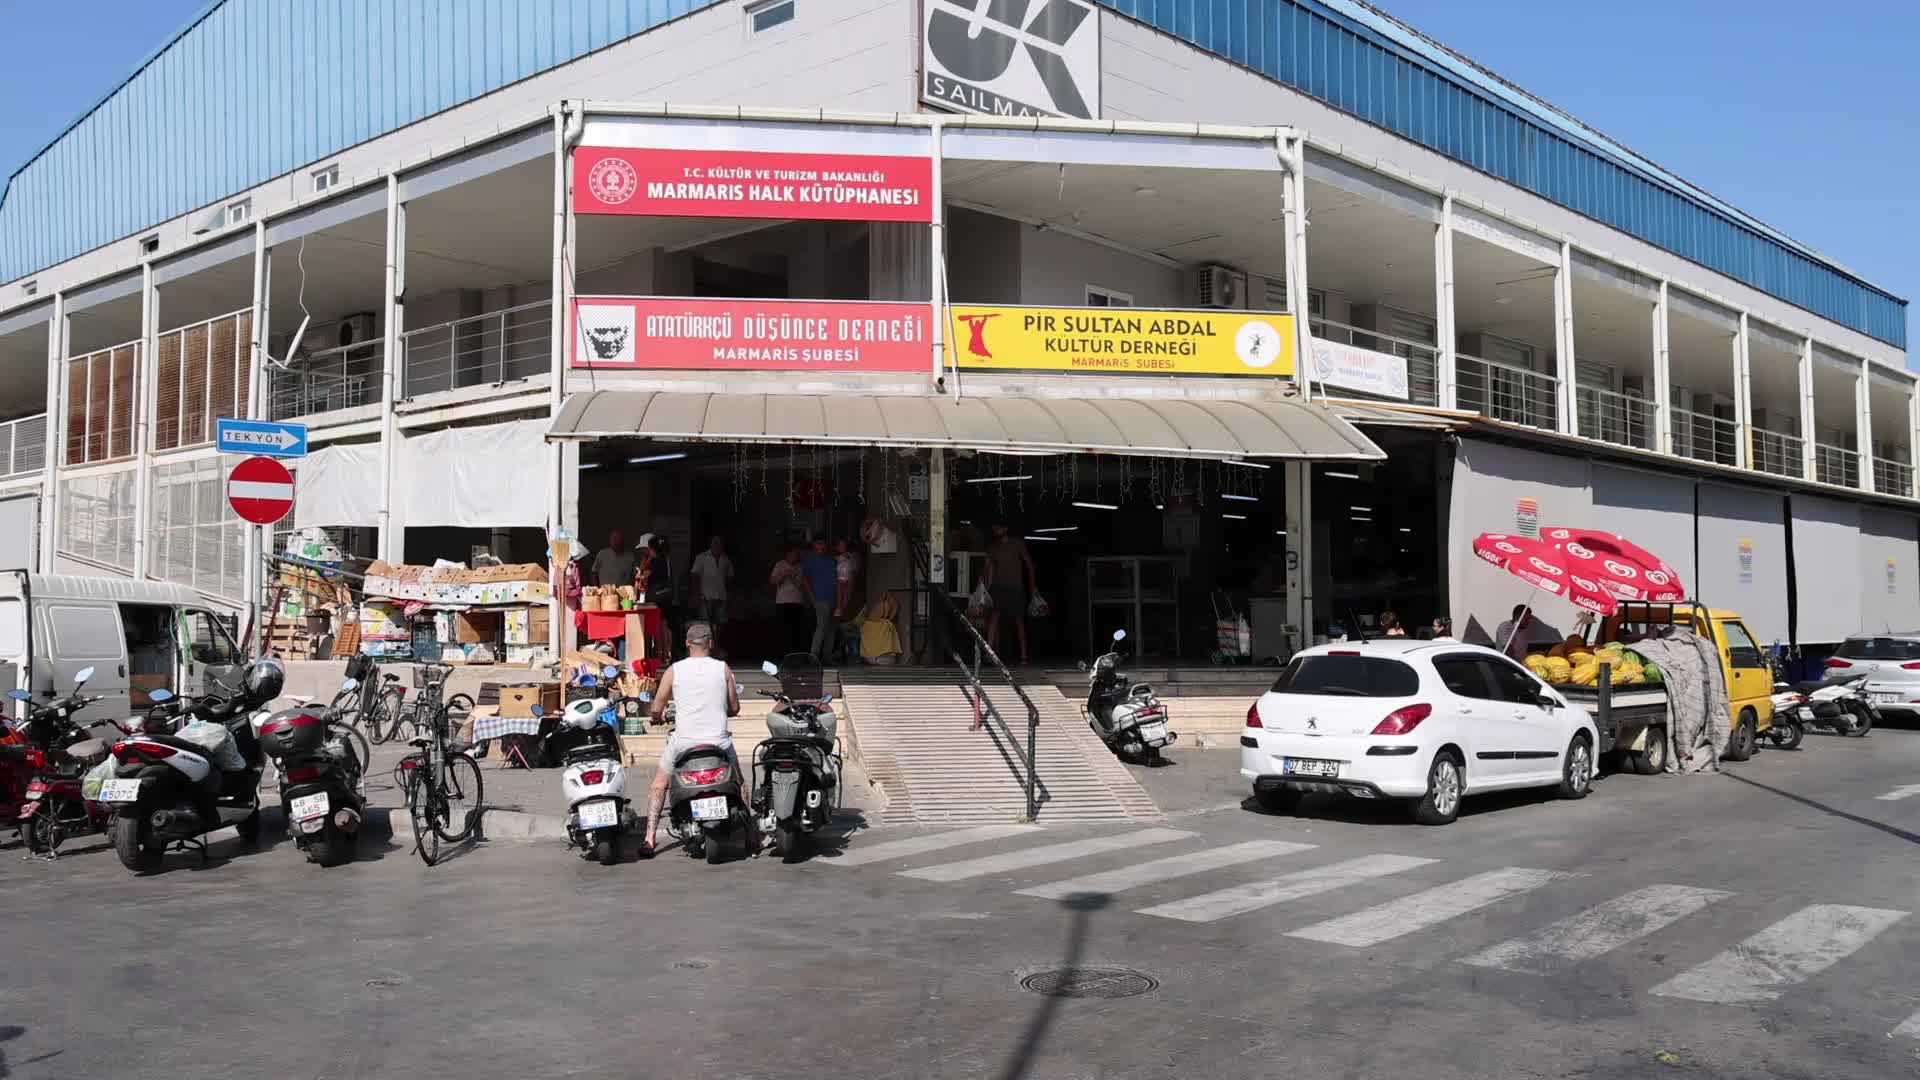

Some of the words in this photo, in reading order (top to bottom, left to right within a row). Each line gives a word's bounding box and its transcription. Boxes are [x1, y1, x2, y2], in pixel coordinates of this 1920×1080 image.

[684, 167, 704, 178] T.C.
[755, 169, 770, 180] VE
[822, 170, 884, 183] BAKANLIĞI
[749, 184, 794, 202] HALK
[646, 312, 732, 340] ATATÜRKÇÜ
[743, 313, 829, 341] DÜŞÜNCE
[838, 315, 923, 342] DERNEĞİ
[1024, 312, 1056, 332] PİR
[1063, 315, 1141, 334] SULTAN
[1149, 319, 1216, 336] ABDAL
[713, 345, 799, 361] MARMARİS
[802, 347, 860, 363] ŞUBESİ
[1045, 334, 1114, 353] KÜLTÜR
[1120, 338, 1196, 356] DERNEĞİ
[225, 431, 251, 441] TEK
[1302, 760, 1317, 771] BEP
[1321, 761, 1336, 772] 324
